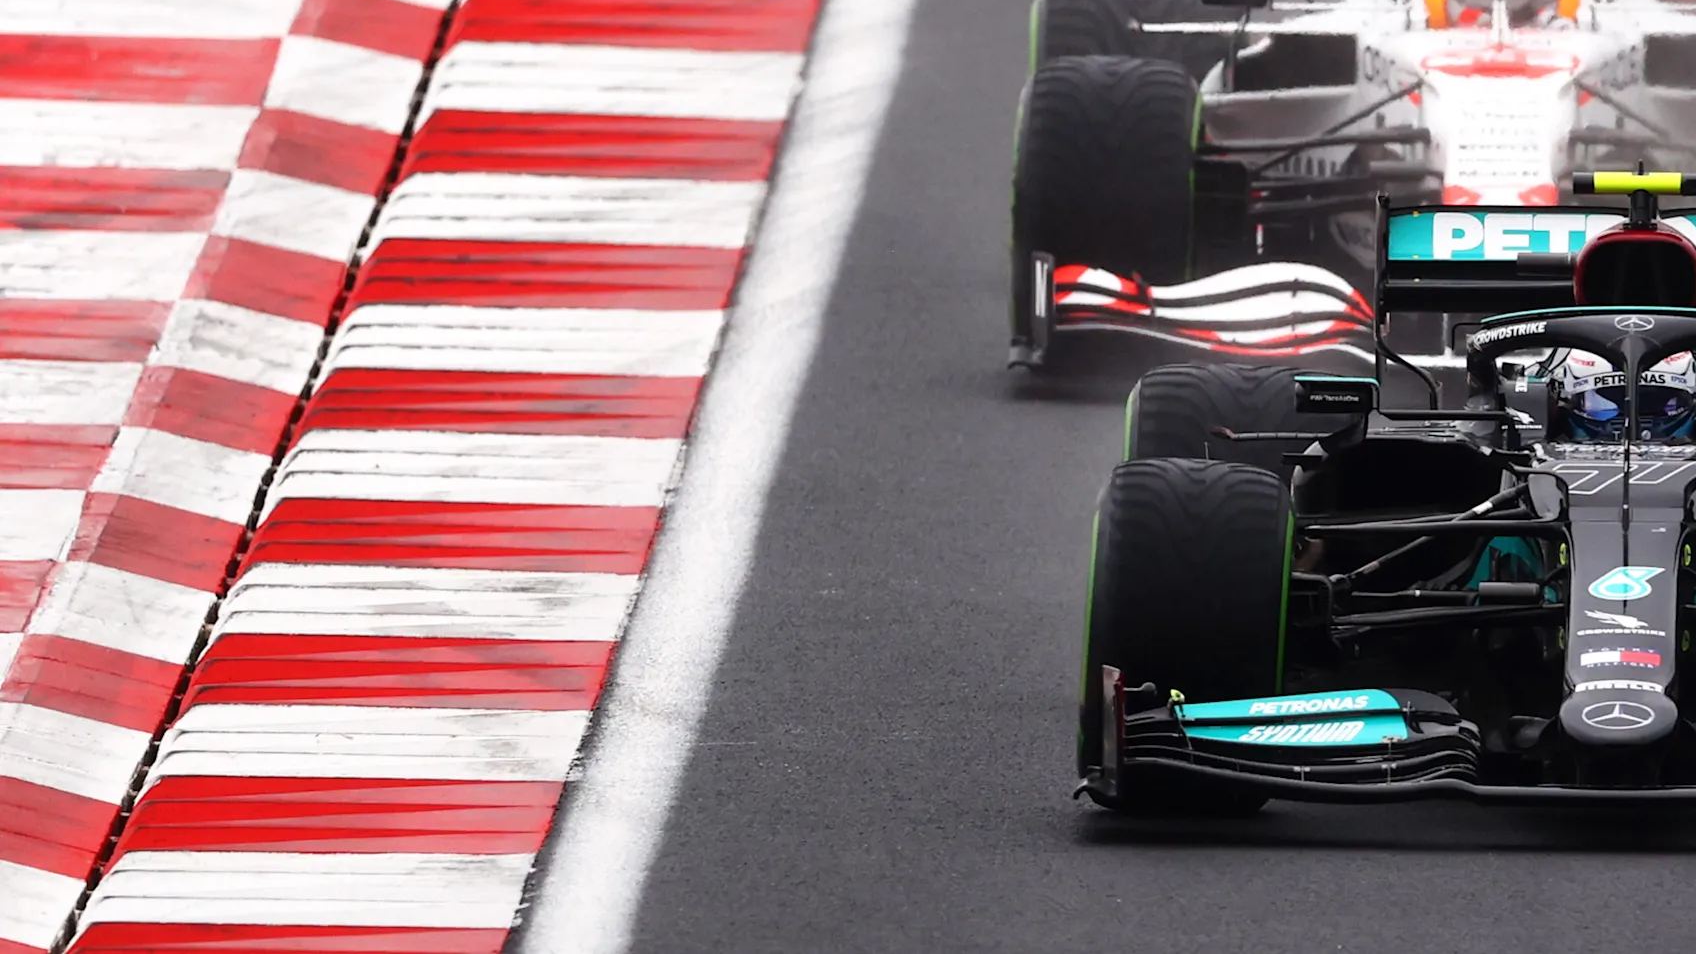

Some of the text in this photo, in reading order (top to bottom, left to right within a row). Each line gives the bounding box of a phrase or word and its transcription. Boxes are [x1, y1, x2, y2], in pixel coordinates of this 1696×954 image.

[1474, 321, 1547, 345] CROWDSTRIKE
[1594, 372, 1666, 387] PETRNAS
[1249, 695, 1369, 714] PETRONAS
[1238, 721, 1366, 743] SYNTIUM
